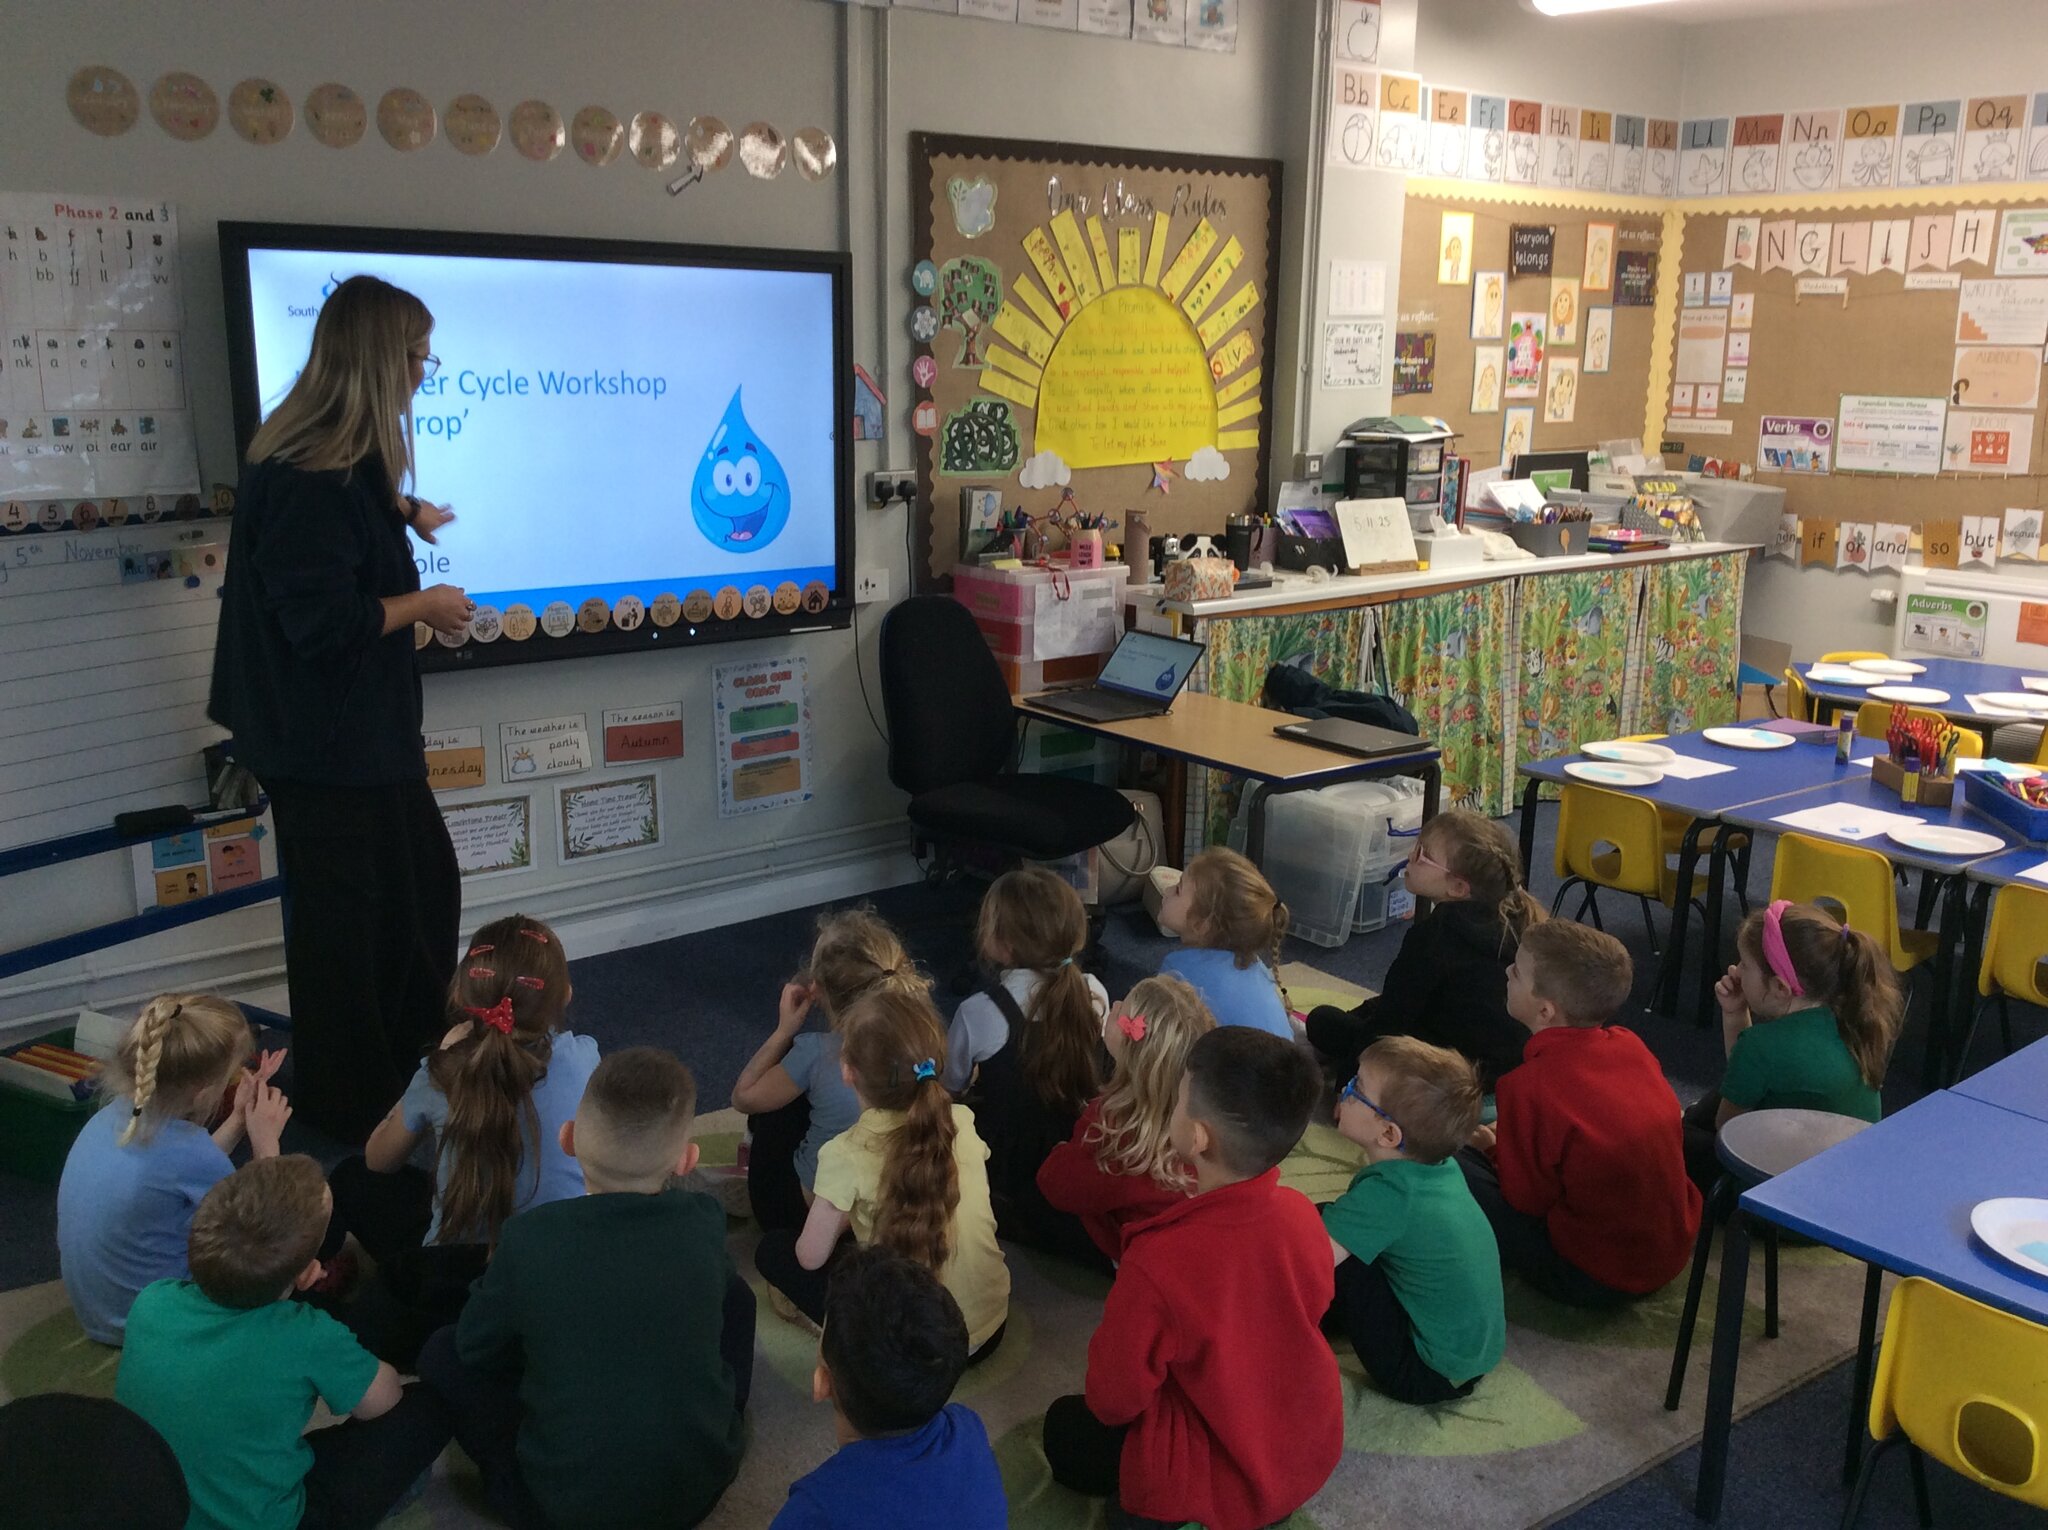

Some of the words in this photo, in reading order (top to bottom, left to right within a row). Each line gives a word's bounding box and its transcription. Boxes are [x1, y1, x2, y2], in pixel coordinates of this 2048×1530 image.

[1344, 74, 1369, 106] Bb
[1438, 92, 1458, 121] Ee
[1479, 98, 1497, 130] Ff
[1551, 108, 1571, 136] Hh
[1793, 115, 1829, 142] Nn
[1852, 110, 1888, 137] Oo
[1918, 105, 1946, 137] Pp
[1740, 120, 1776, 143] Mm
[54, 203, 103, 220] Phase
[109, 206, 119, 220] 2
[125, 208, 155, 222] and
[1515, 231, 1549, 247] Everyone
[1515, 250, 1549, 270] Belongs
[459, 369, 529, 401] Cycle
[538, 368, 667, 400] Workshop
[1766, 420, 1801, 434] Verbs
[8, 503, 20, 519] 4
[47, 505, 57, 519] 5
[146, 495, 155, 511] 8
[1812, 531, 1827, 549] if
[1874, 539, 1908, 556] and
[1964, 529, 1994, 548] but
[64, 536, 144, 562] November
[1930, 542, 1950, 556] so
[1912, 599, 1953, 611] Adverbs
[733, 674, 767, 688] CLASS
[611, 713, 628, 723] The
[632, 711, 664, 721] season
[666, 709, 675, 717] is
[507, 726, 526, 736] The
[530, 723, 566, 735] weather
[569, 721, 578, 729] is
[448, 735, 459, 744] is
[549, 735, 580, 753] partly
[620, 734, 671, 750] Autumn
[546, 755, 583, 770] cloudy
